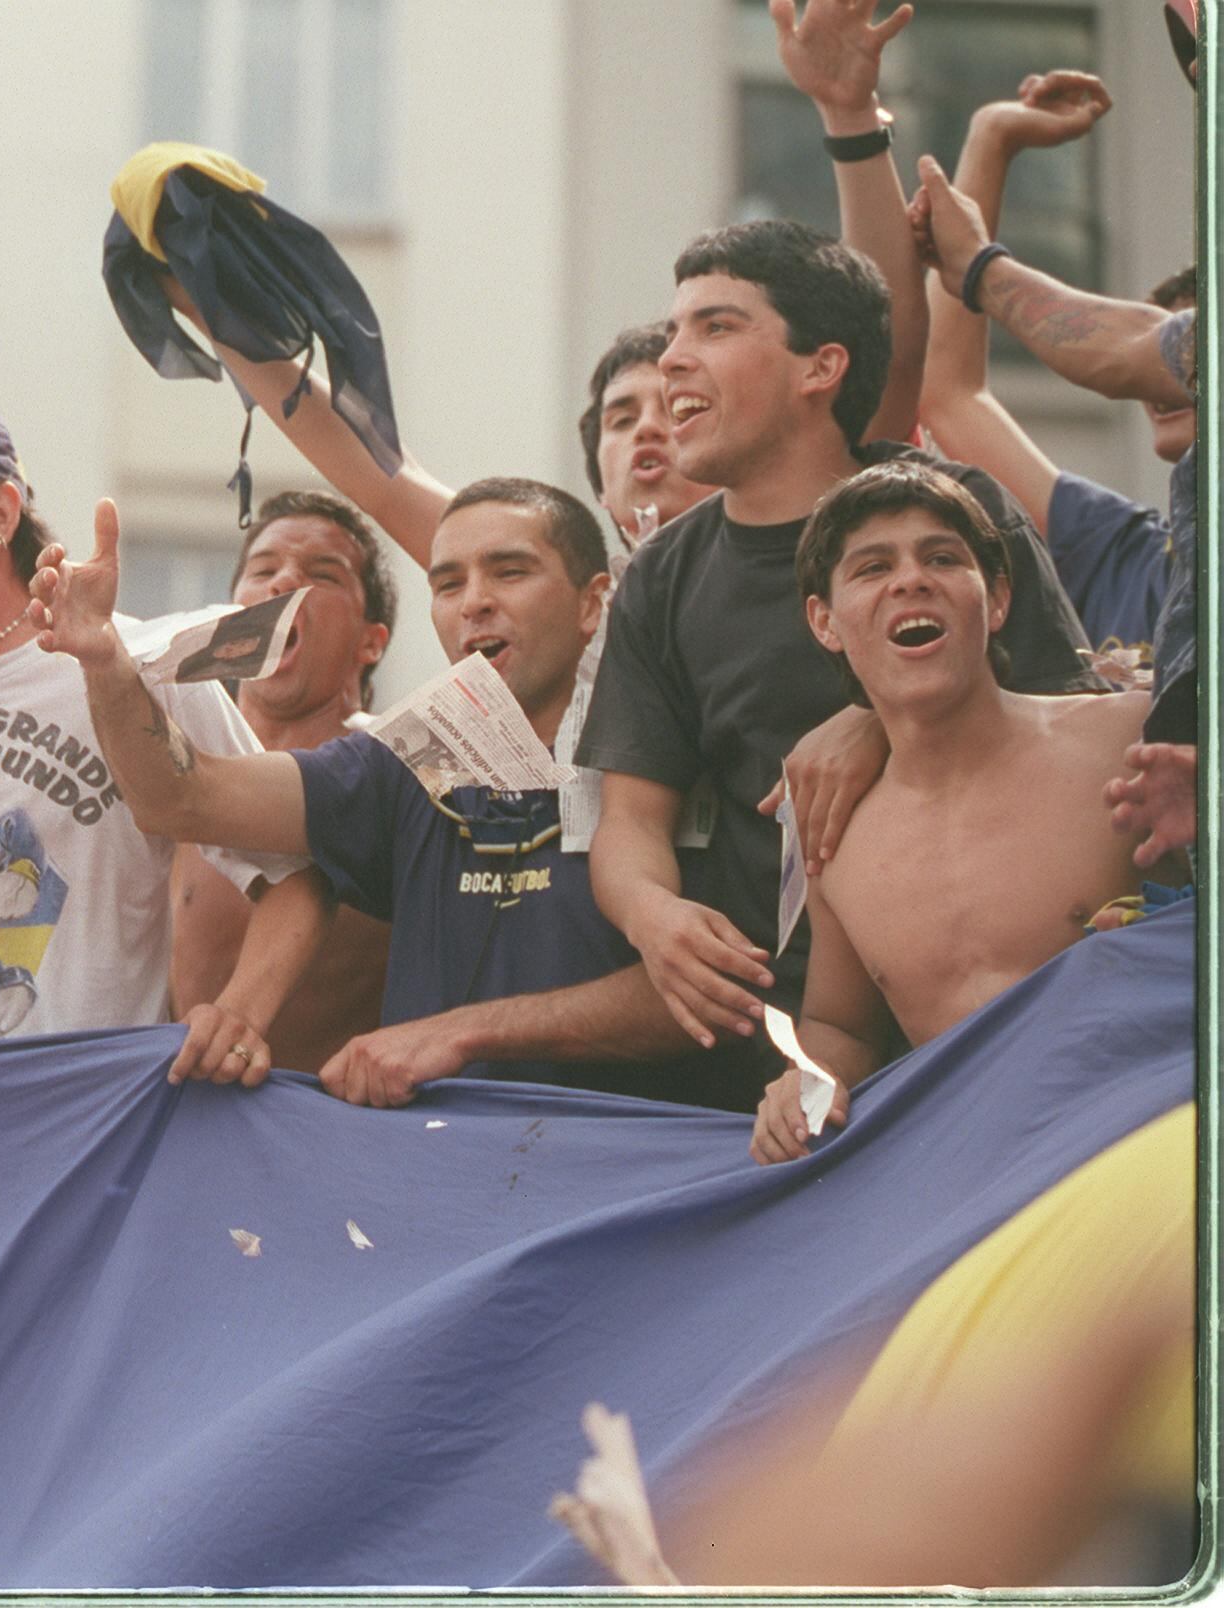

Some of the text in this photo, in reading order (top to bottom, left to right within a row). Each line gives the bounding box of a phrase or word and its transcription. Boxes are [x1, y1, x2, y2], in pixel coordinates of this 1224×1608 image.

[427, 704, 462, 741] ocupados
[458, 739, 493, 776] edificios
[459, 871, 502, 894] BOCA
